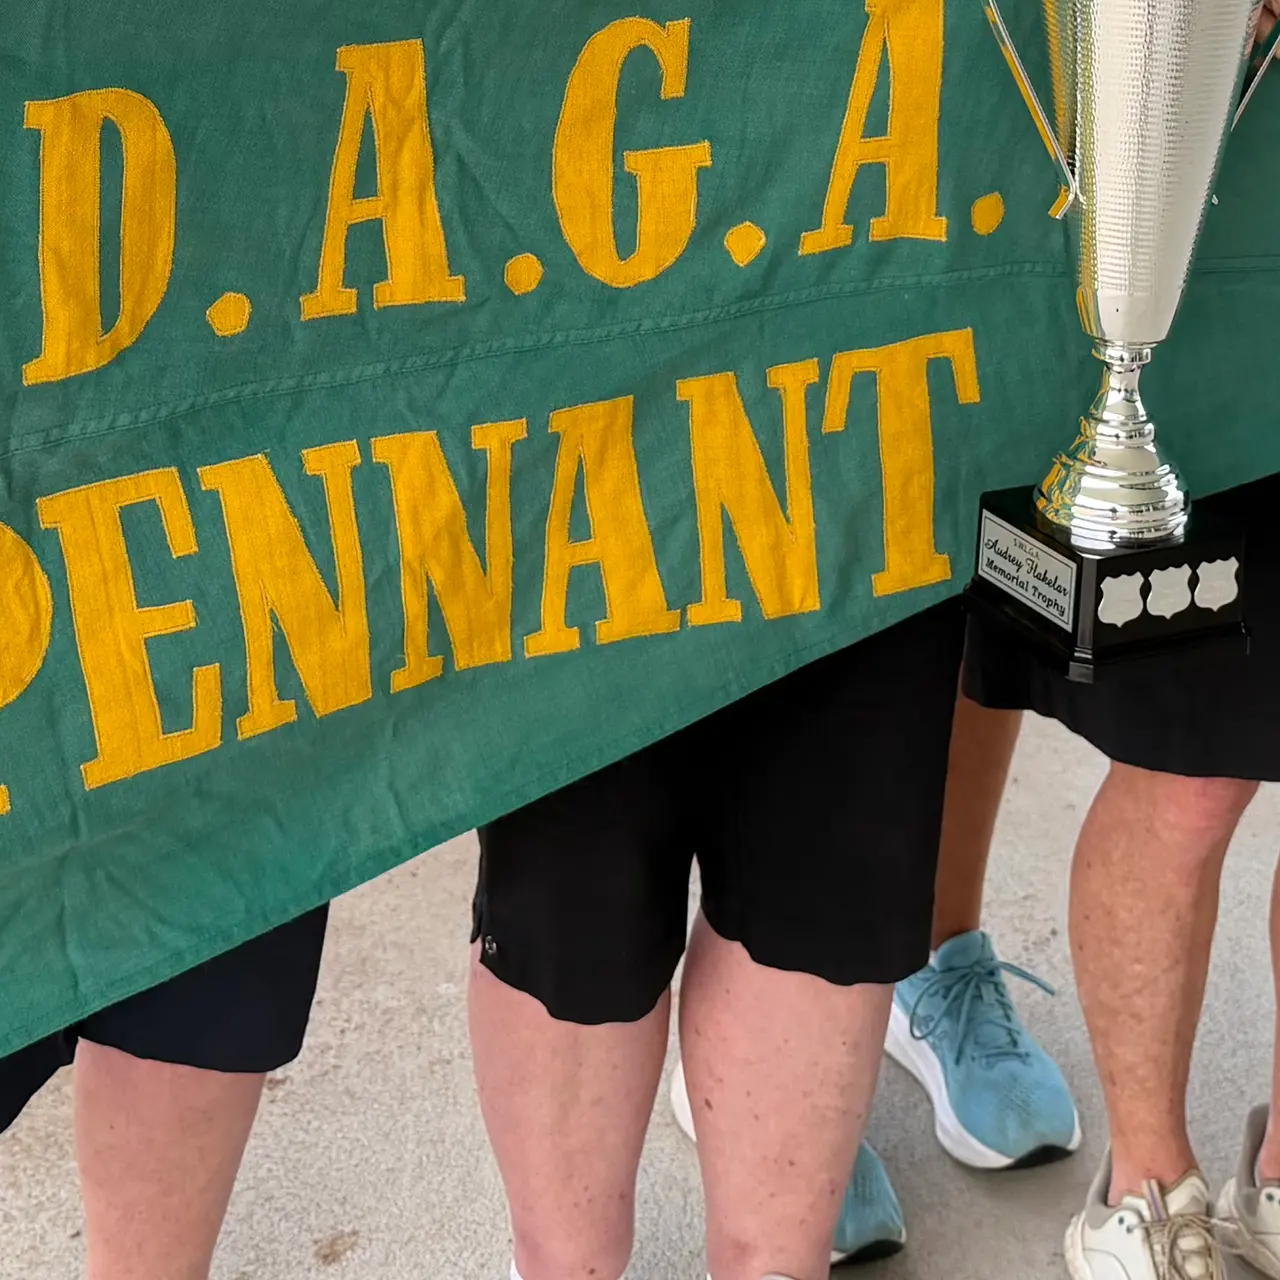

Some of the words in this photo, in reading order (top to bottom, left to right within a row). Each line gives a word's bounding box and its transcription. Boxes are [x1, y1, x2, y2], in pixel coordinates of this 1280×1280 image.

[984, 539, 1024, 573] Audrey
[985, 557, 1029, 592] Memorial
[1031, 586, 1066, 617] Trophy
